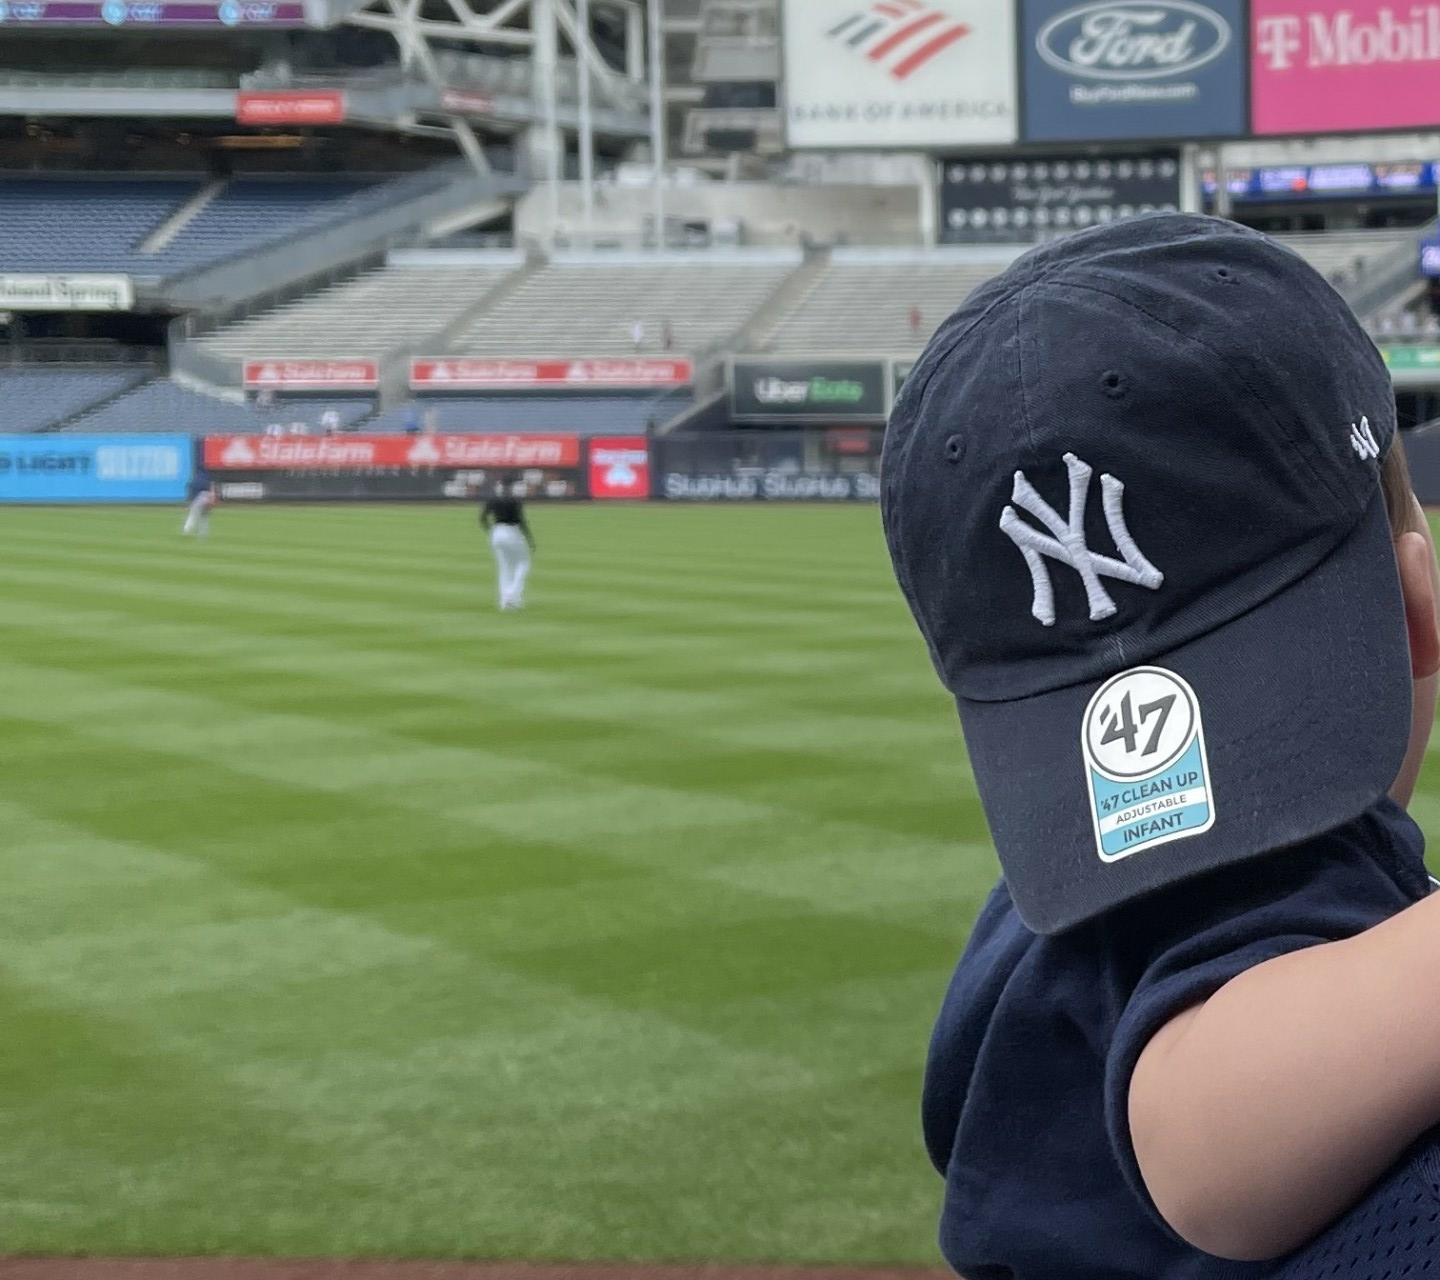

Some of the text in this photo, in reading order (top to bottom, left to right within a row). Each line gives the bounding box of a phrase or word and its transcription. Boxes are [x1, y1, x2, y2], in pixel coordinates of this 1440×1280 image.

[1068, 9, 1197, 68] Ford
[1121, 779, 1172, 804] CLEAN
[1175, 771, 1198, 788] UP
[1116, 794, 1187, 825] ADJUSTABLE
[1123, 812, 1184, 843] INFANT
